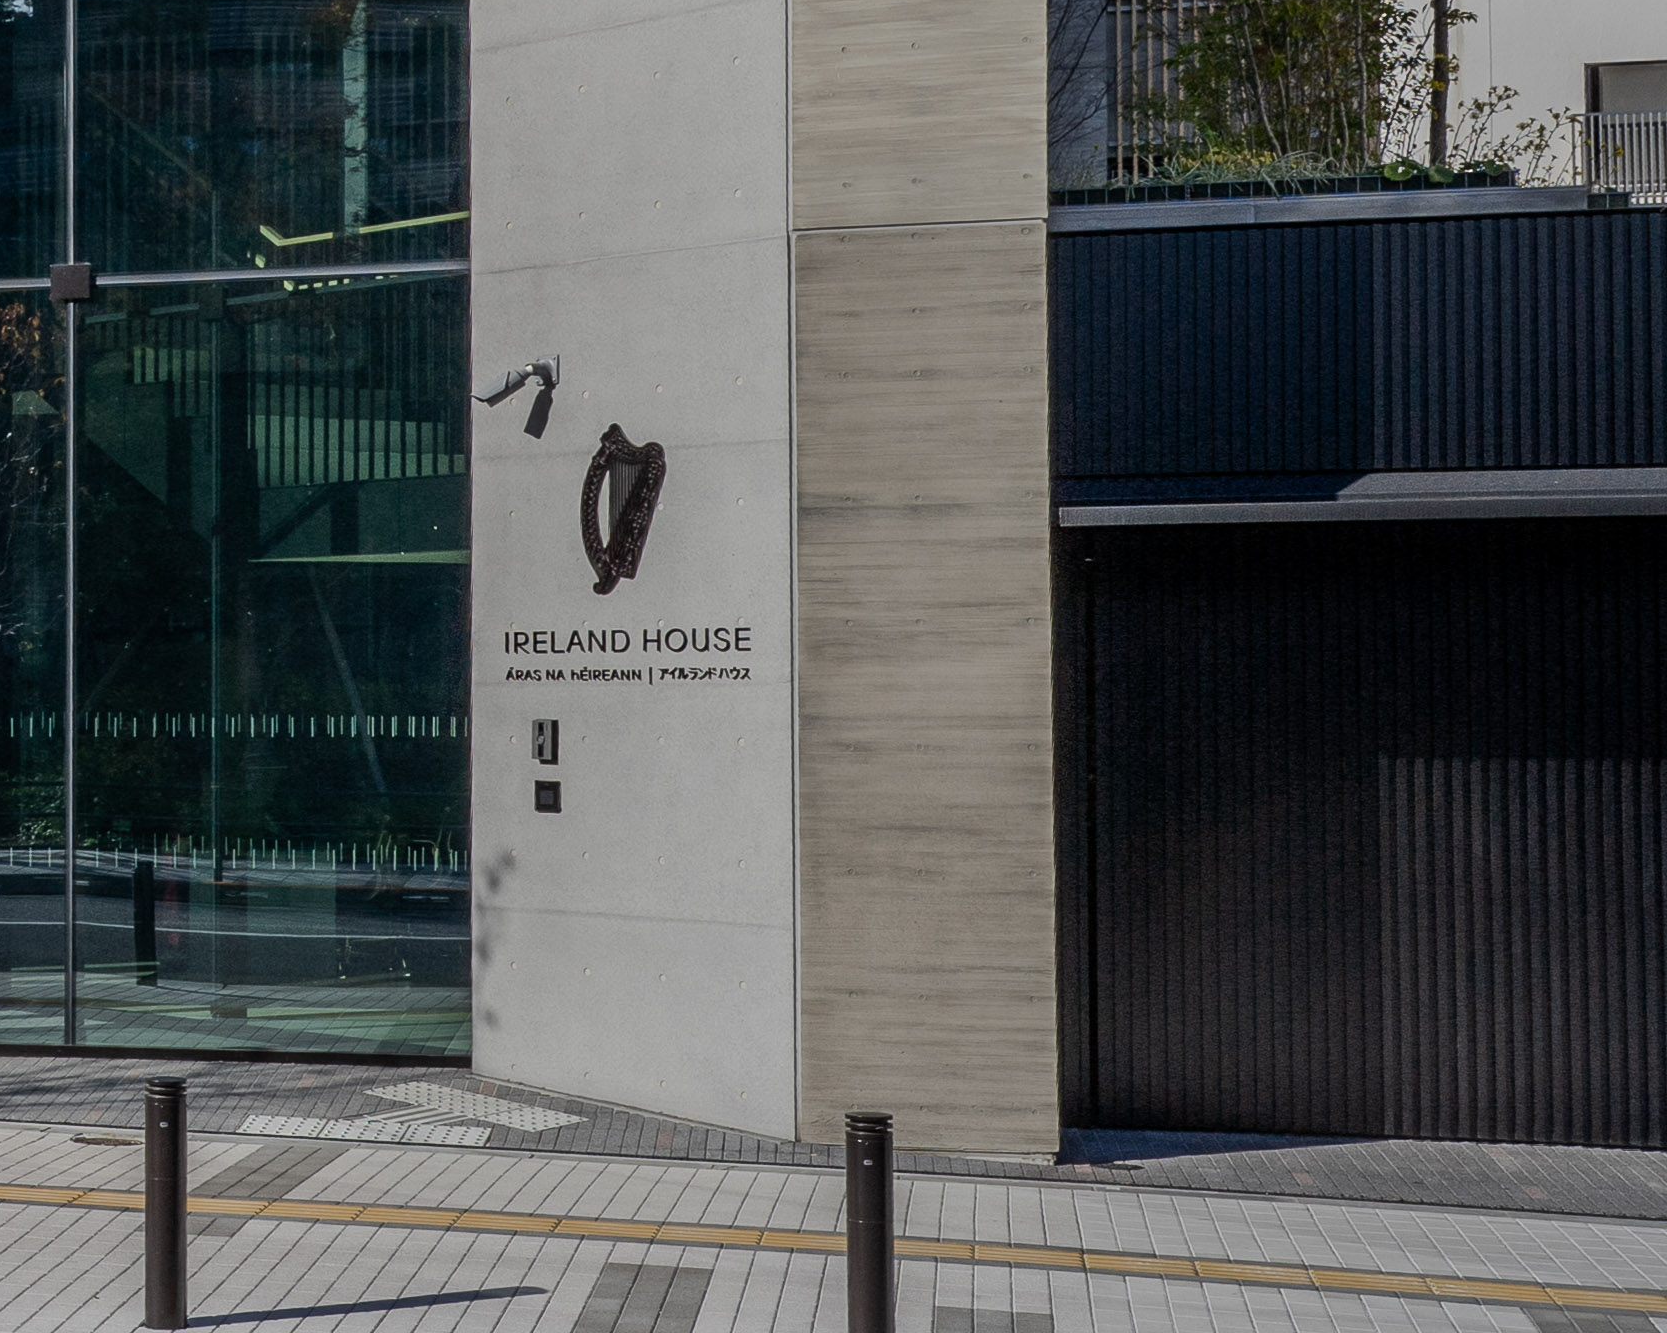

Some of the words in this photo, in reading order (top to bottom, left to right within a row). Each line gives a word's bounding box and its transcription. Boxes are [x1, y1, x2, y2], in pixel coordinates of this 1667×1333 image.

[504, 629, 631, 655] IRELAND
[642, 627, 752, 653] HOUSE
[505, 666, 542, 681] ÁRAS
[545, 668, 566, 681] NA
[570, 666, 642, 682] hÉIREANN
